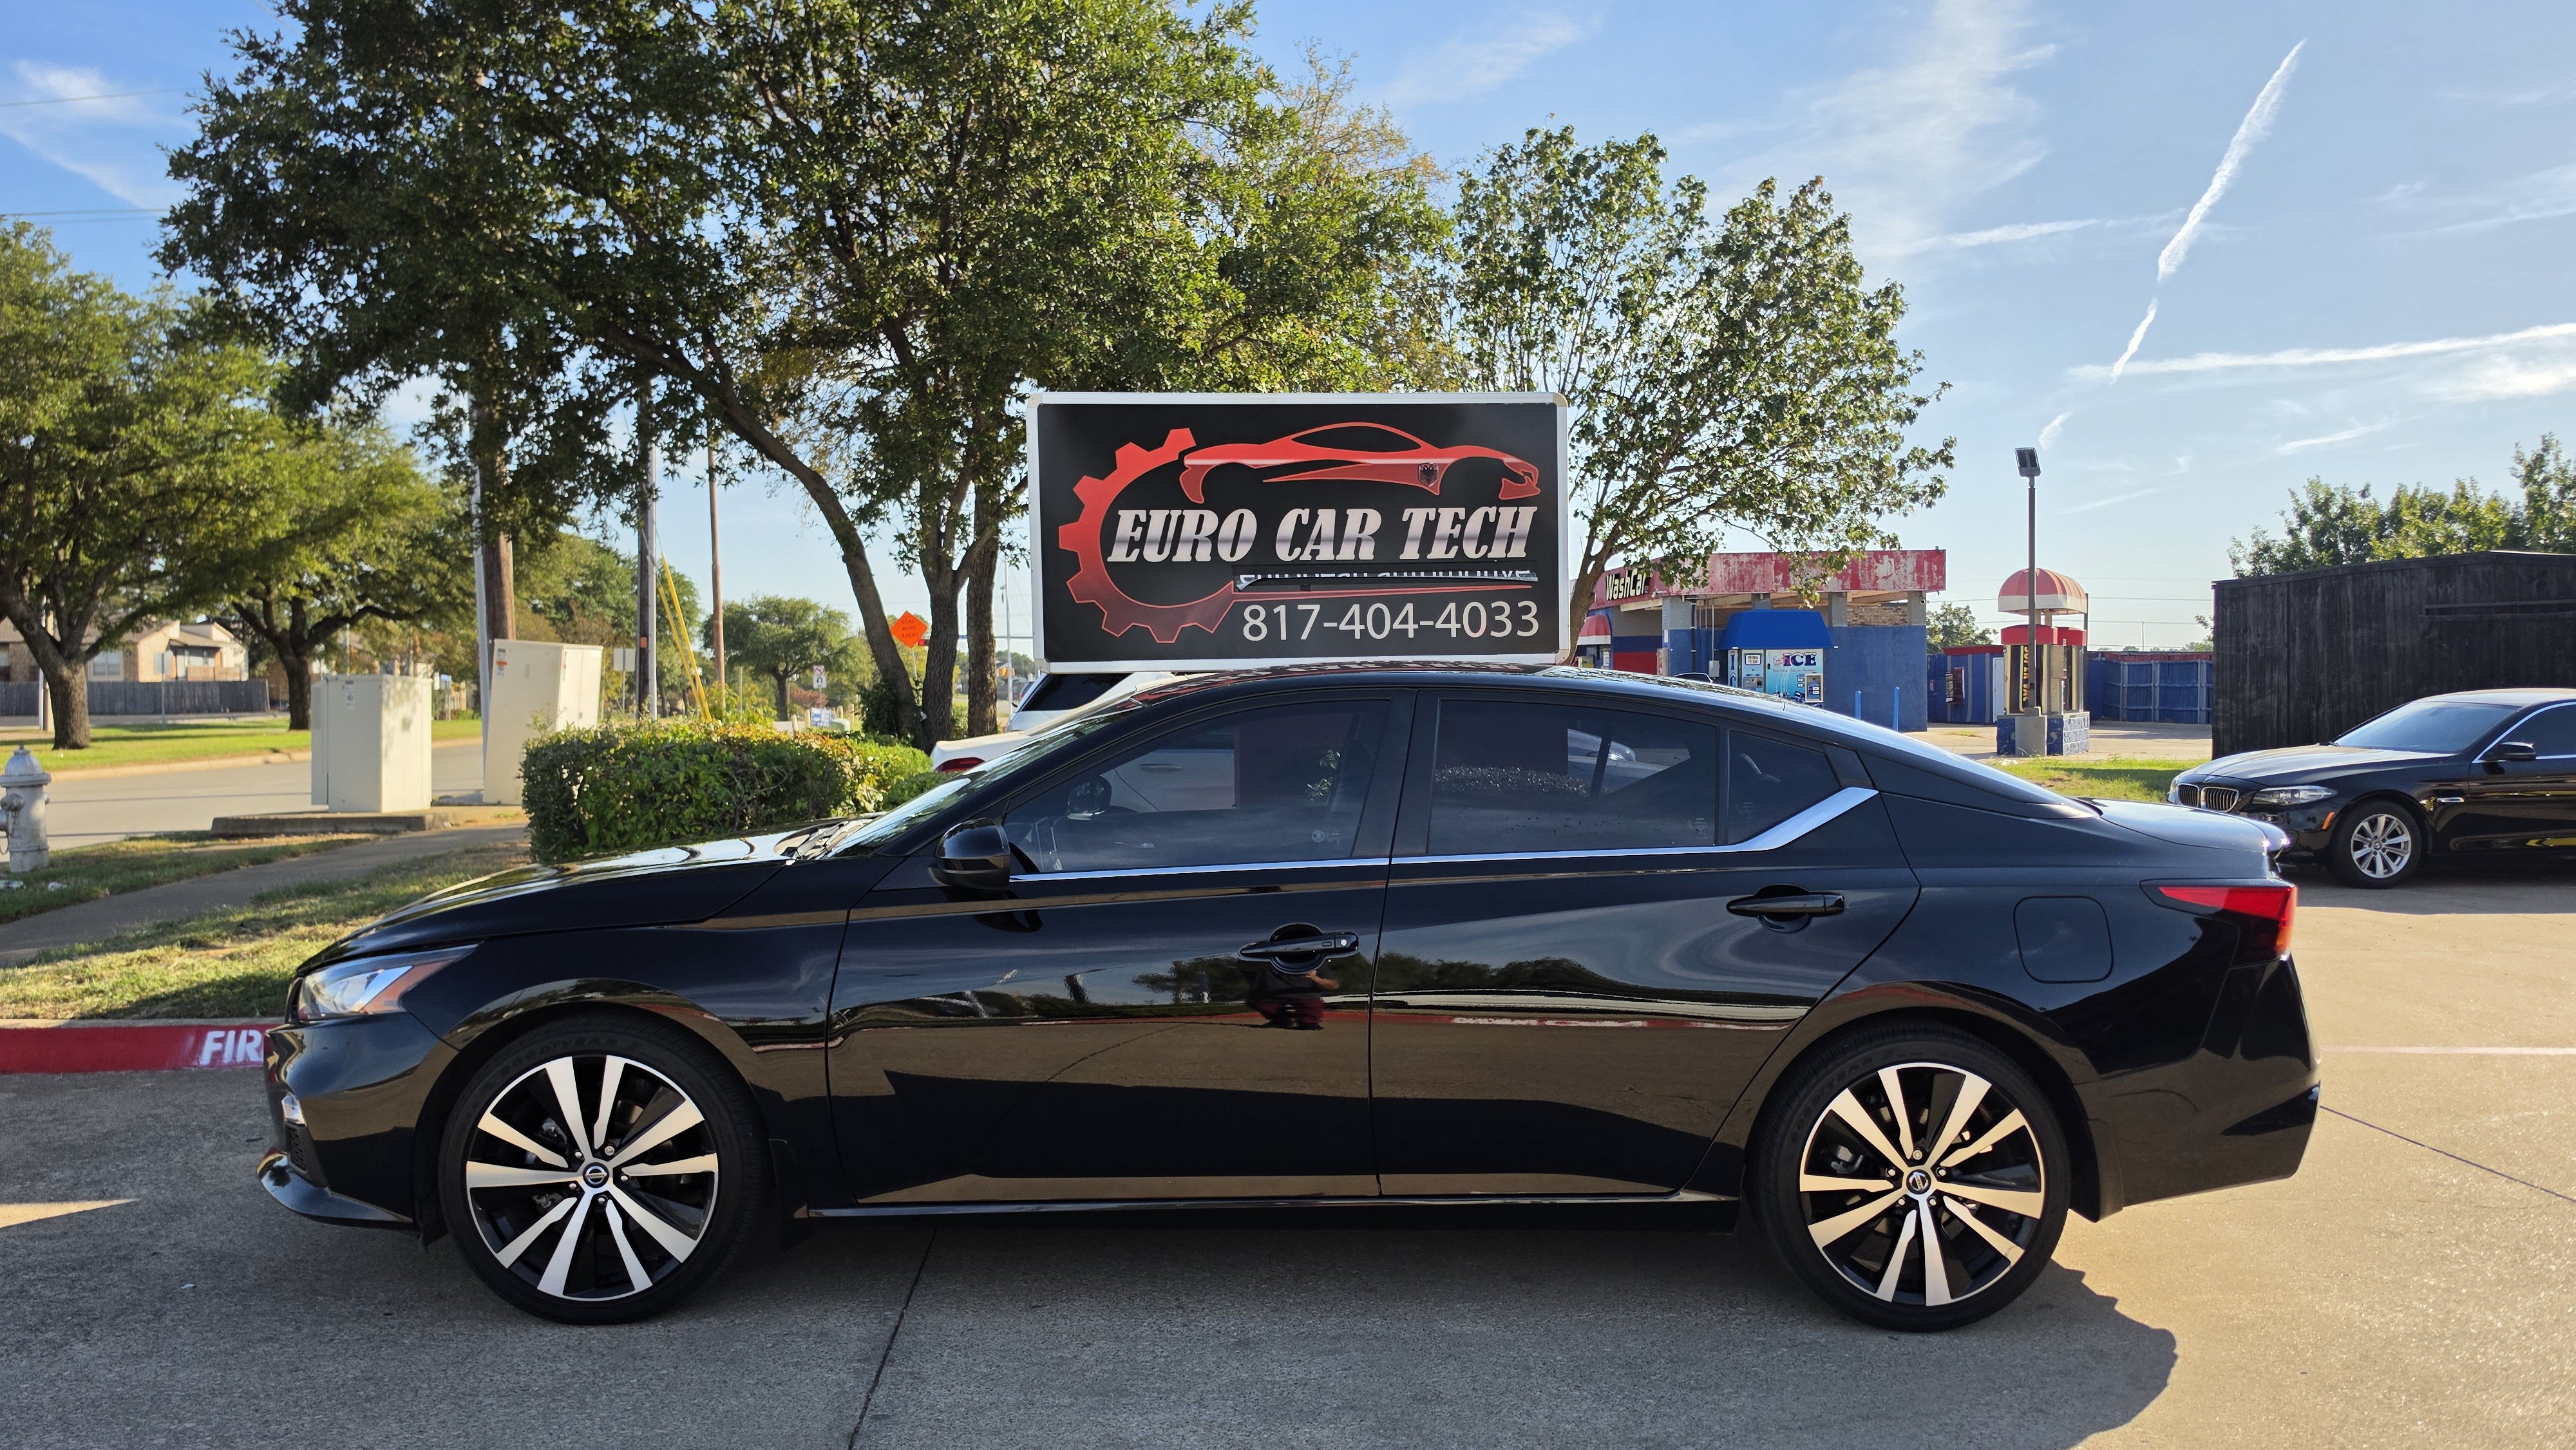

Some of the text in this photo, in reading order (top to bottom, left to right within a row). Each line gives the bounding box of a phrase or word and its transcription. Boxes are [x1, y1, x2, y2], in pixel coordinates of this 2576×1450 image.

[1107, 506, 1538, 562] EURO CAR TECH
[1242, 601, 1539, 641] 817-404-4033
[1783, 652, 1817, 666] ICE
